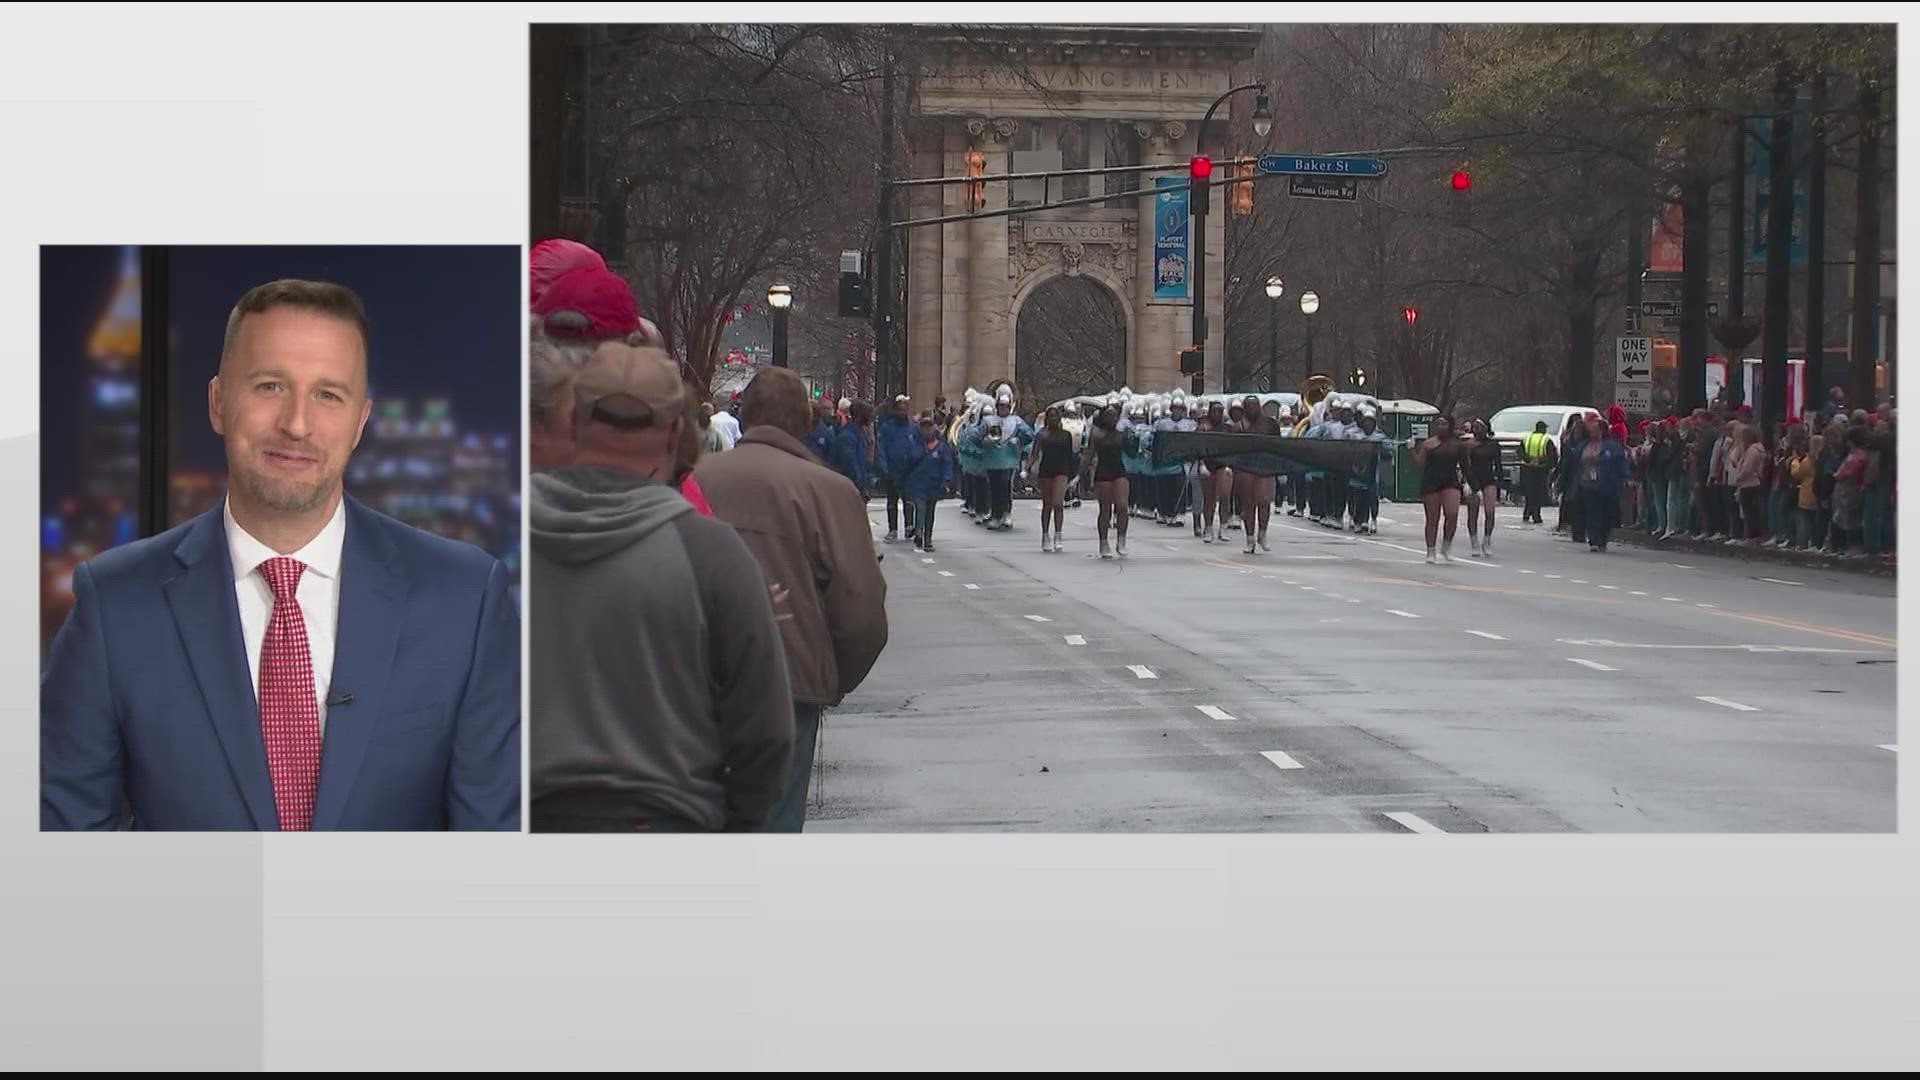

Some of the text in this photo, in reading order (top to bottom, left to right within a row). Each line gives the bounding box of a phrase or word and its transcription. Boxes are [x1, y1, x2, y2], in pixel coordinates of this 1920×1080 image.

[1295, 160, 1331, 171] Baker
[1336, 160, 1349, 171] St
[1341, 187, 1354, 199] Way
[1033, 226, 1114, 238] CARNEGIE
[1622, 339, 1646, 350] ONE
[1622, 352, 1647, 363] WAY
